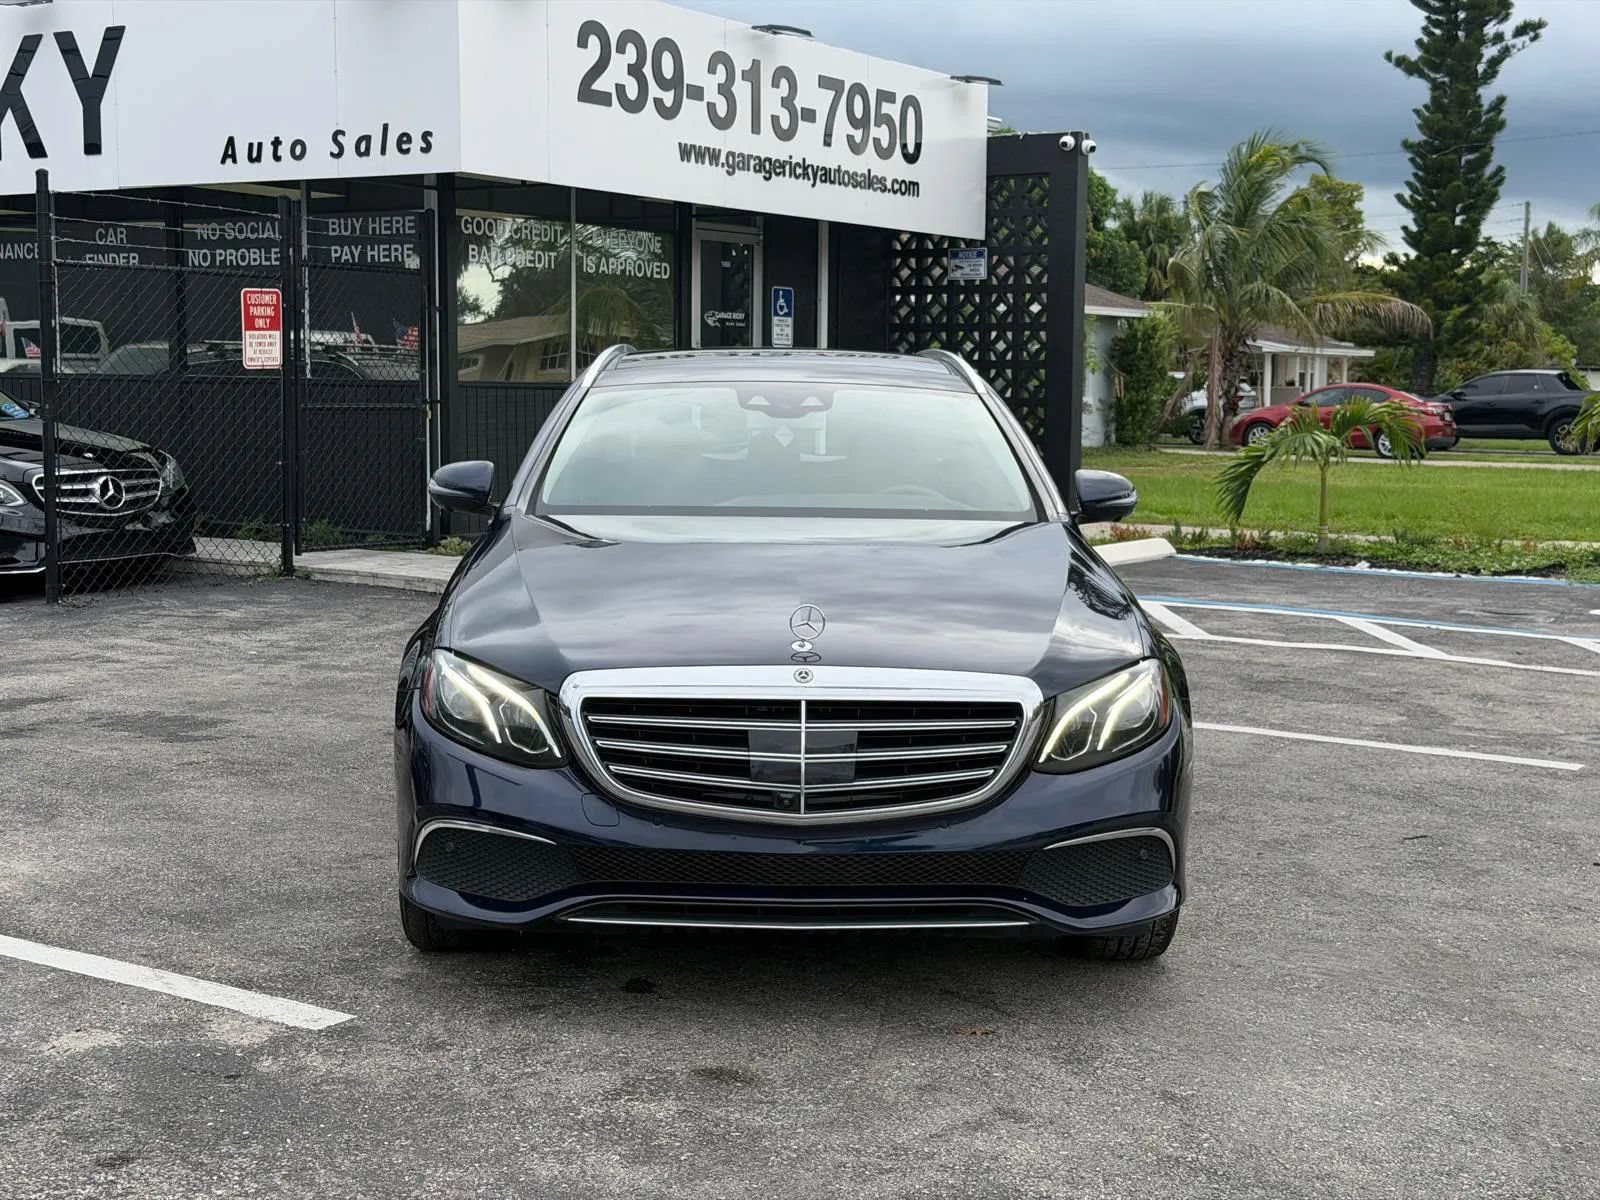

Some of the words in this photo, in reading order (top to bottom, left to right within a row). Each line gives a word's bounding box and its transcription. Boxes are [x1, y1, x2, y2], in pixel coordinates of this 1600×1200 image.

[577, 20, 923, 165] 239-313-7950
[220, 136, 307, 165] Auto
[329, 123, 434, 159] Sales
[678, 142, 920, 198] www.garagerickyautosales.com
[96, 227, 127, 245] CAR
[196, 222, 220, 241] NO
[328, 217, 362, 236] BUY
[368, 215, 416, 235] HERE
[461, 216, 508, 238] GOOD
[511, 221, 563, 243] CREDIT
[592, 230, 662, 254] EVERYONE
[188, 248, 211, 267] NO
[331, 245, 362, 263] PAY
[367, 244, 415, 263] HERE
[468, 244, 501, 267] BAD
[504, 246, 558, 269] CREDIT
[583, 254, 596, 274] IS
[599, 256, 671, 280] APPROVED
[247, 293, 277, 305] CUSTOMER
[250, 306, 275, 317] PARKING
[254, 318, 271, 329] ONLY
